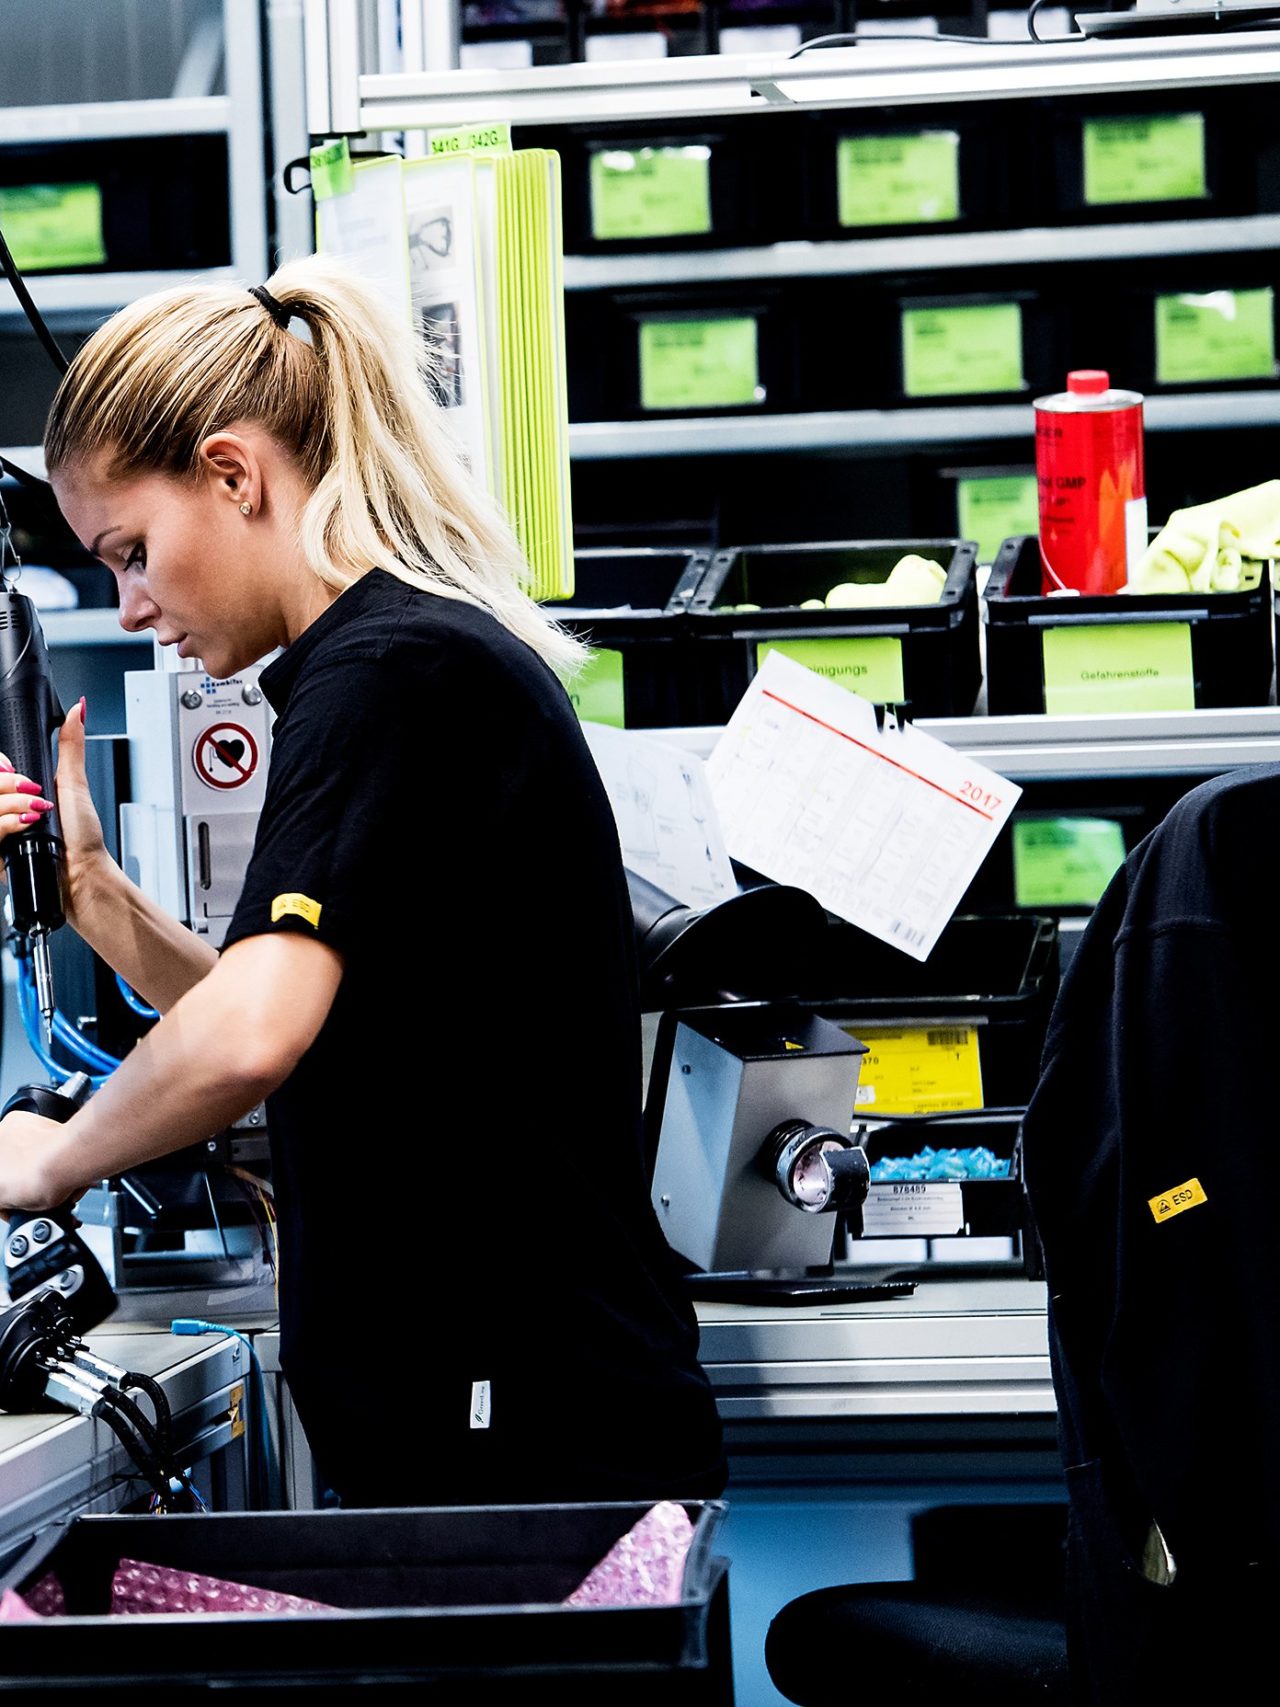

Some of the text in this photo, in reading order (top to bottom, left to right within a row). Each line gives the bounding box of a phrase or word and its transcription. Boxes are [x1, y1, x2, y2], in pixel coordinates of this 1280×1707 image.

[808, 666, 868, 677] inigungs
[1081, 668, 1159, 680] Gefahrenstoffe
[960, 781, 1002, 810] 2017
[1172, 1189, 1193, 1206] ESD
